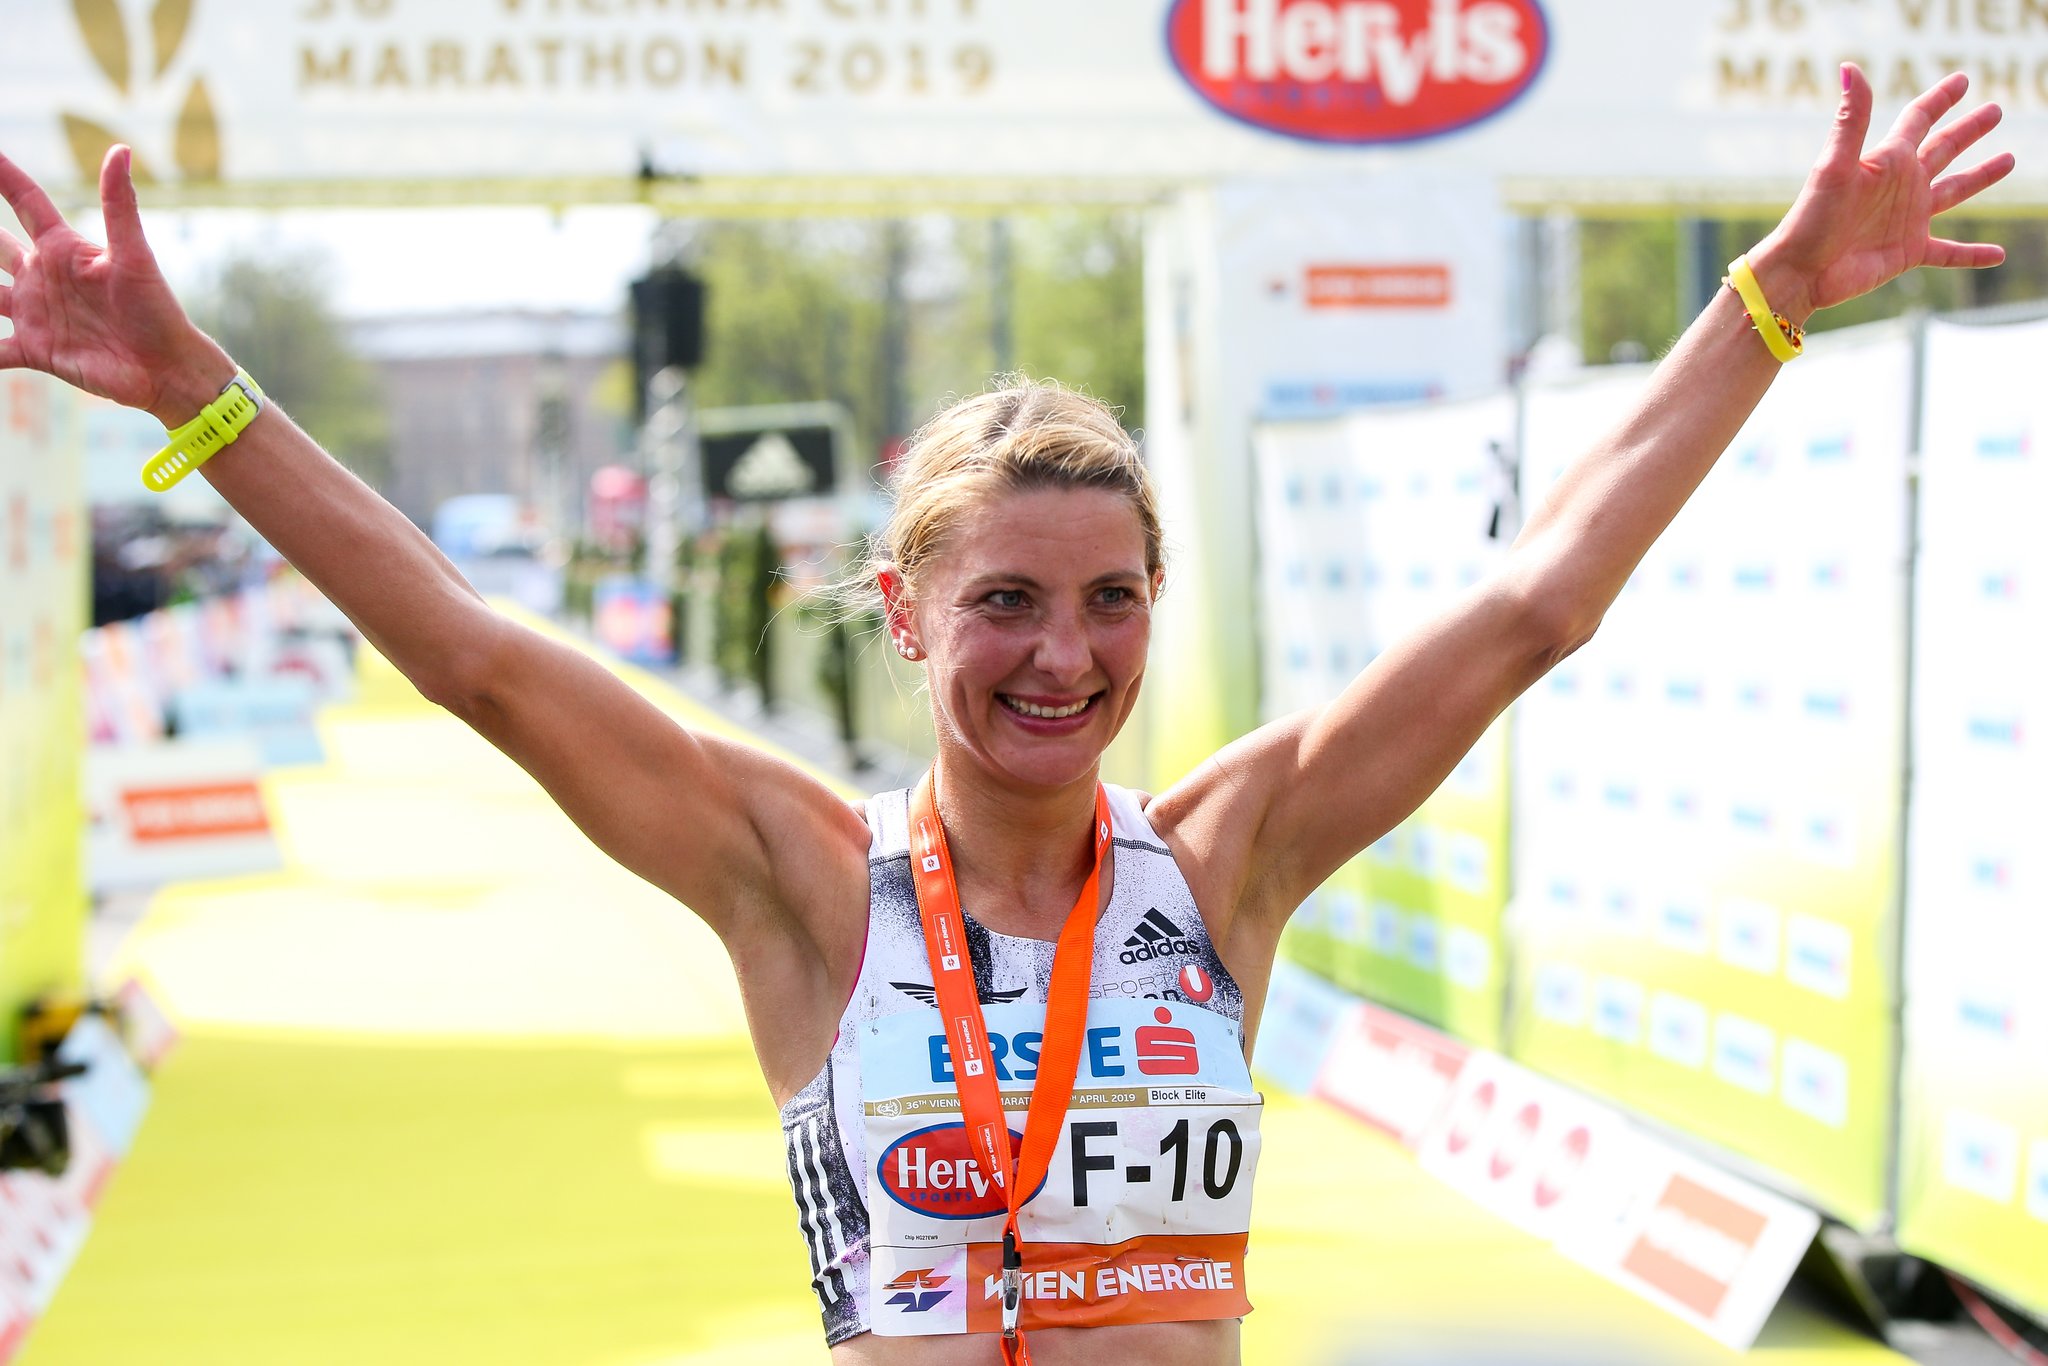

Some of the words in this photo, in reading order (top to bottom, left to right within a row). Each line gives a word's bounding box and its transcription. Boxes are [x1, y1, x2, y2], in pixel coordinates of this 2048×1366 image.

[298, 40, 745, 88] MARATHON
[789, 42, 995, 92] 2019
[1203, 0, 1526, 105] Hervis
[1119, 938, 1200, 964] adidas
[928, 1027, 1126, 1082] ERSE
[906, 1099, 927, 1110] 36TH
[929, 1098, 961, 1108] VIENN
[1079, 1094, 1109, 1104] APRIL
[1111, 1093, 1136, 1103] 2019
[1151, 1090, 1180, 1101] Block
[1185, 1089, 1206, 1100] Elite
[897, 1147, 1018, 1198] Herv
[1070, 1118, 1243, 1207] F-10
[1096, 1262, 1234, 1298] ENERGIE
